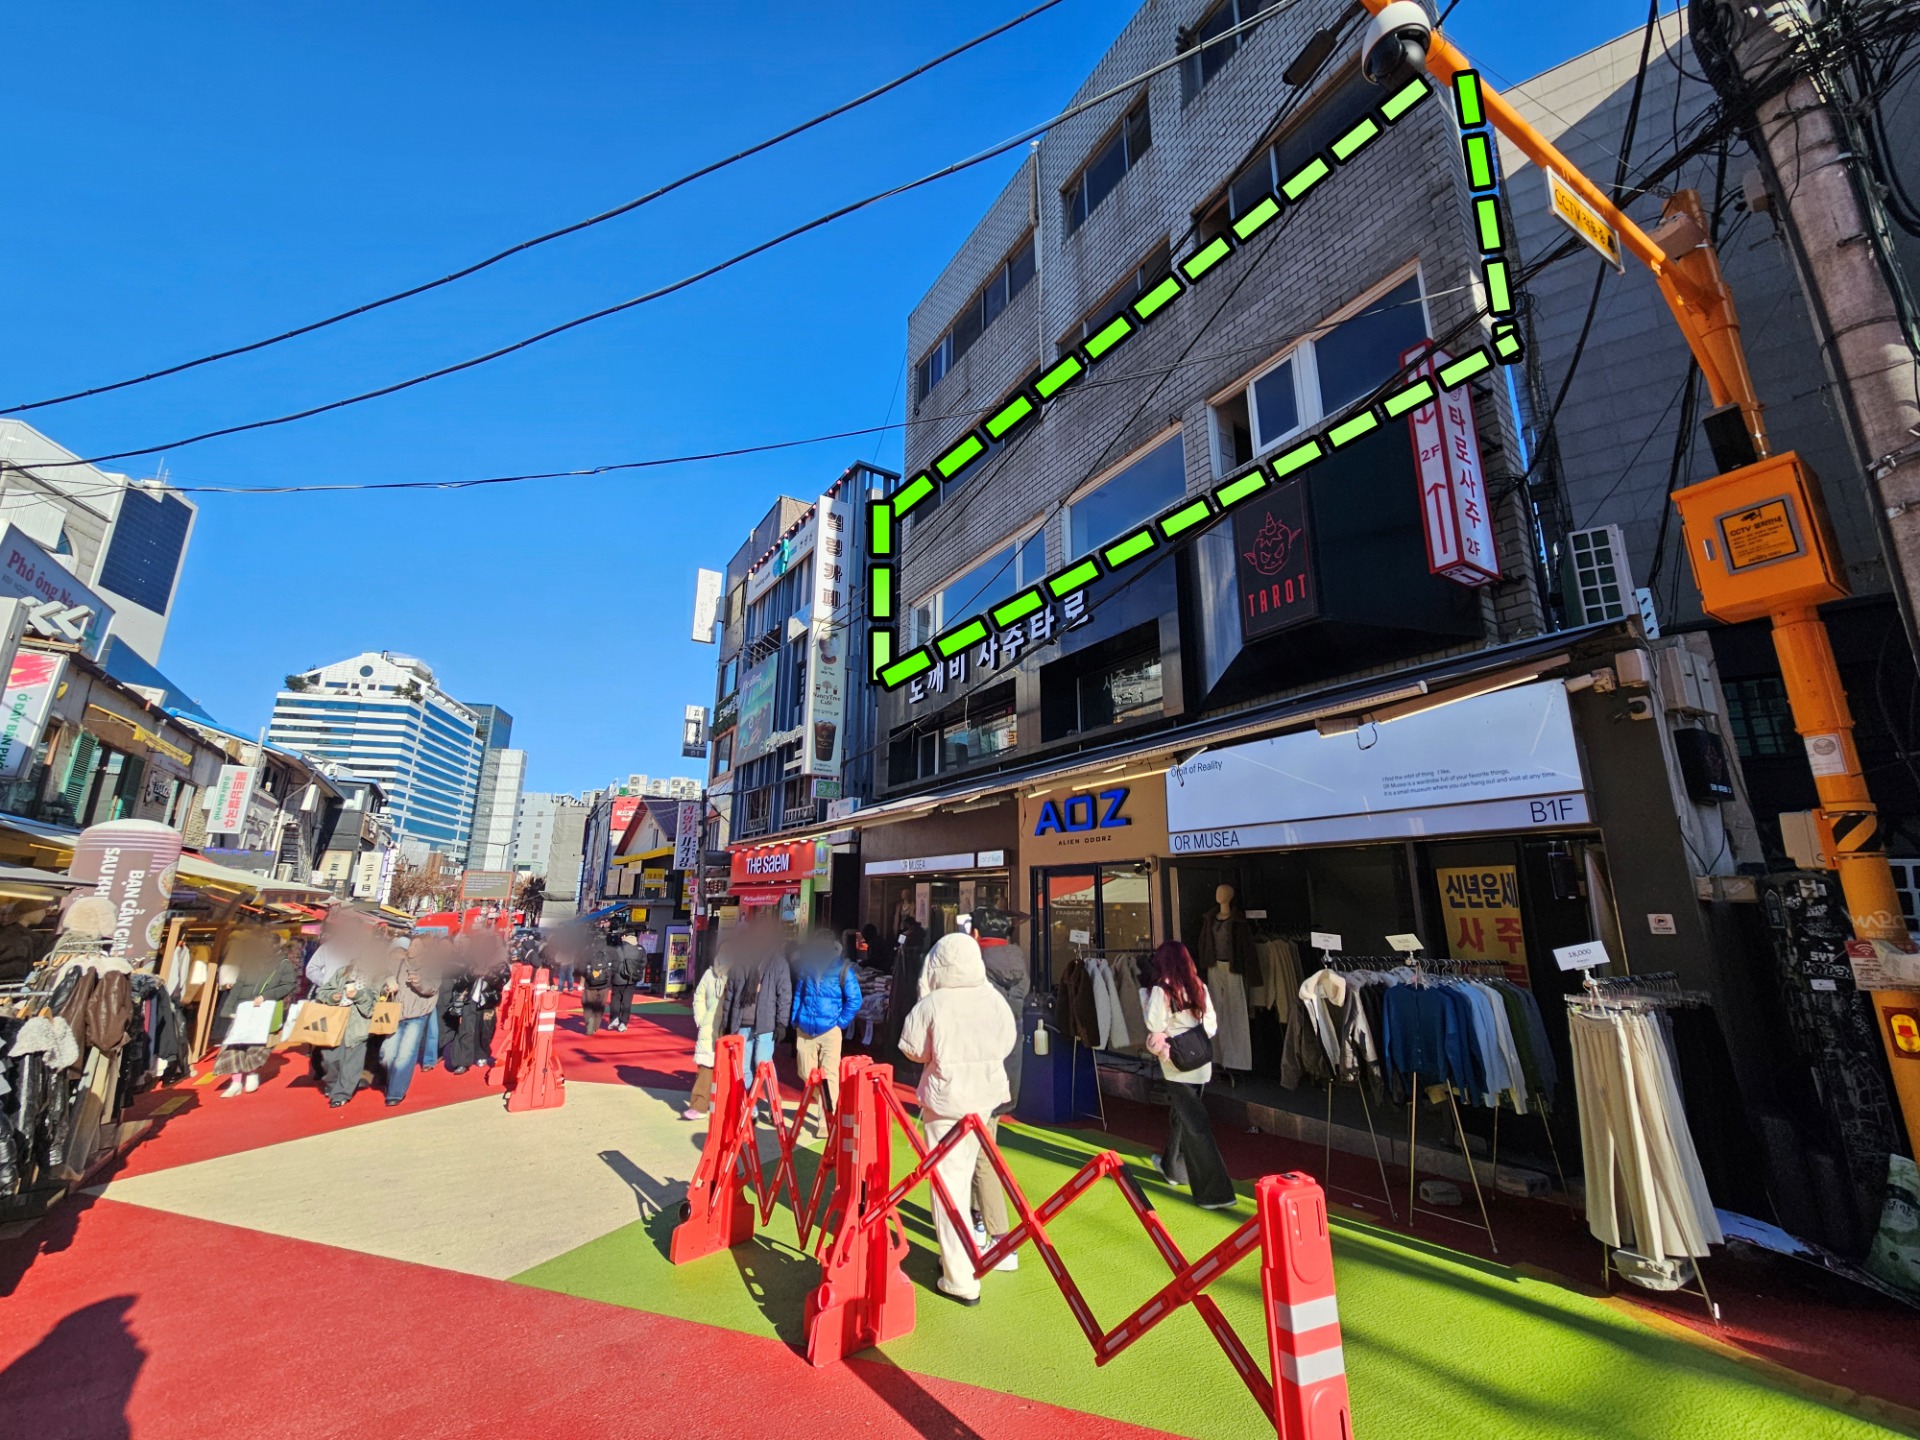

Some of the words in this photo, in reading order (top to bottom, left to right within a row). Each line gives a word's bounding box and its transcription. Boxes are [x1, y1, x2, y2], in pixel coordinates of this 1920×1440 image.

[1554, 188, 1581, 222] CCTV
[1421, 444, 1441, 462] 2F
[1729, 525, 1752, 537] CCTV
[1466, 536, 1481, 557] 2F
[823, 511, 844, 609] 힐링카페
[1248, 573, 1306, 618] TAROT
[1188, 764, 1196, 775] of
[1197, 760, 1223, 773] Reality
[1468, 771, 1490, 779] favorite
[1034, 787, 1131, 836] AOZ
[1529, 797, 1574, 823] B1F
[1058, 838, 1080, 846] ALIEN
[1174, 834, 1191, 851] OR
[1193, 830, 1240, 850] MUSEA
[100, 847, 121, 875] SAU
[908, 859, 927, 871] MUSEA
[1057, 893, 1089, 905] AOZ
[1445, 872, 1519, 909] 신년운세
